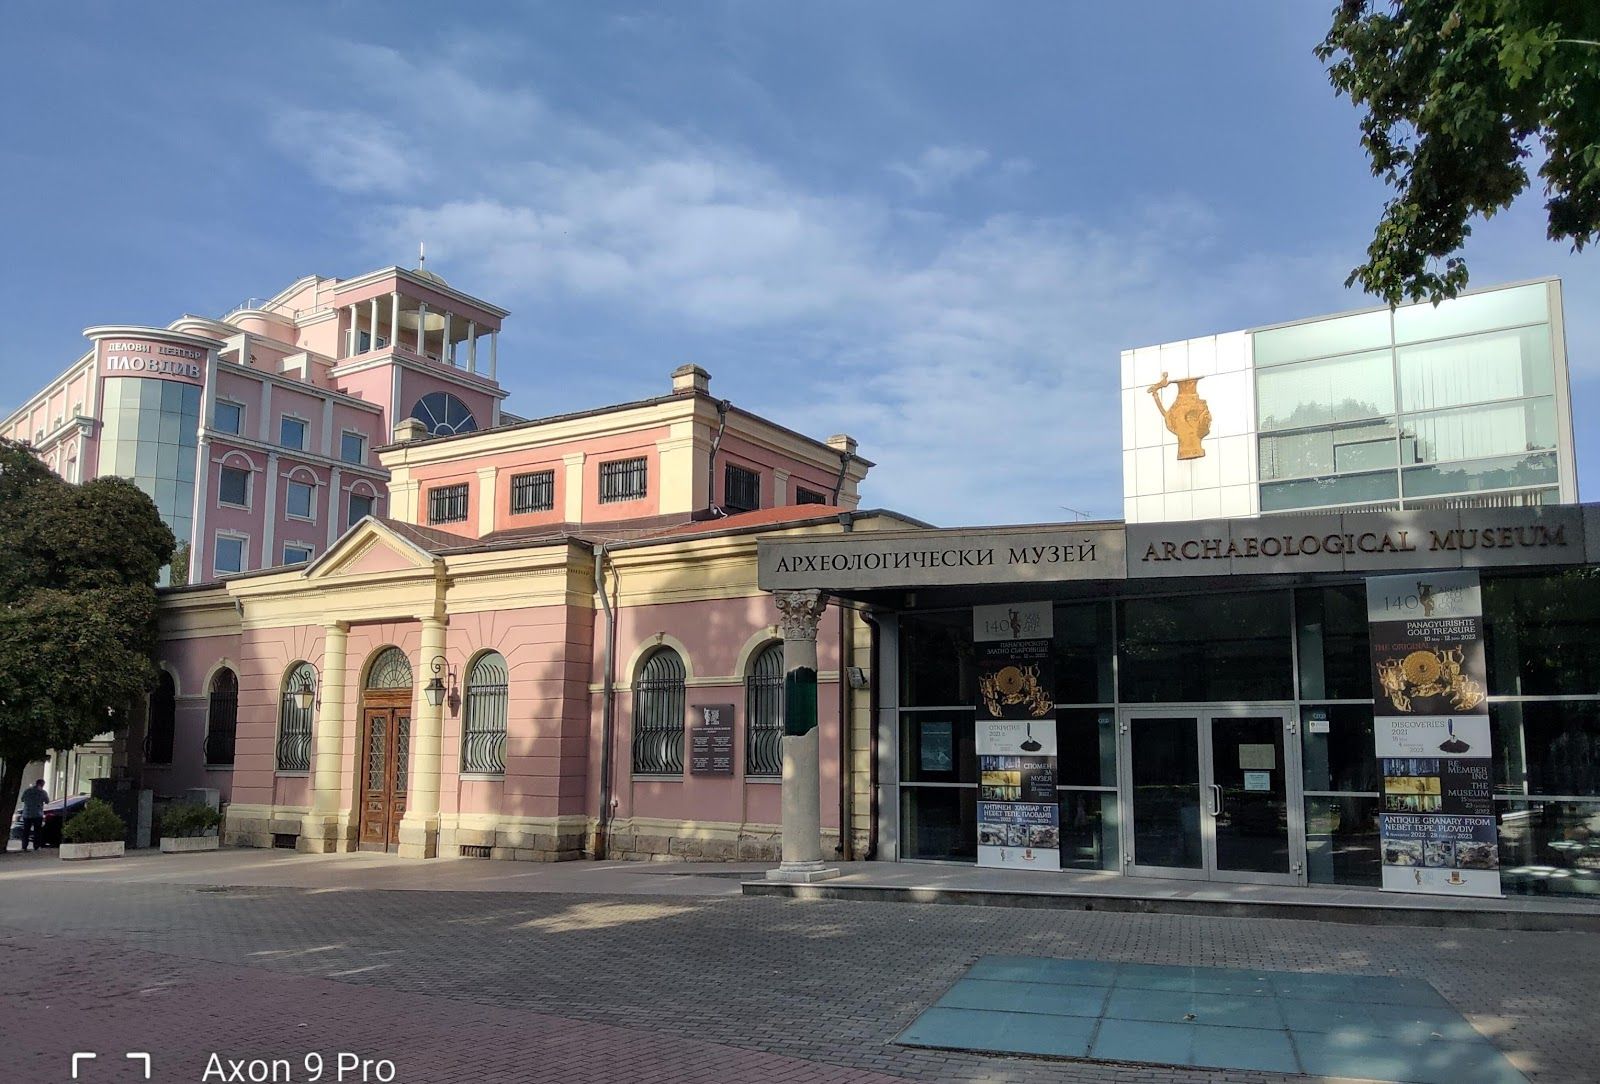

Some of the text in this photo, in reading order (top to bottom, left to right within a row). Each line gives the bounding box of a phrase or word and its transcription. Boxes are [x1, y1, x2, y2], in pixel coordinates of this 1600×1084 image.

[107, 342, 201, 359] ДЕЛОВИ ЦЕНТЪР
[106, 356, 201, 378] ПЛОВДИВ
[1142, 525, 1567, 561] ARCHAEOLOGICAL MUSEUM
[776, 540, 1098, 573] АРХЕОЛОГИЧЕСКИ МУЗЕЙ
[1385, 594, 1418, 611] 140
[1407, 619, 1475, 629] PANAGYURISHTE
[1432, 626, 1476, 635] TREASURE
[1384, 816, 1490, 826] ANTIQUE GRANARY FROM
[1439, 825, 1474, 833] PLOVDIV
